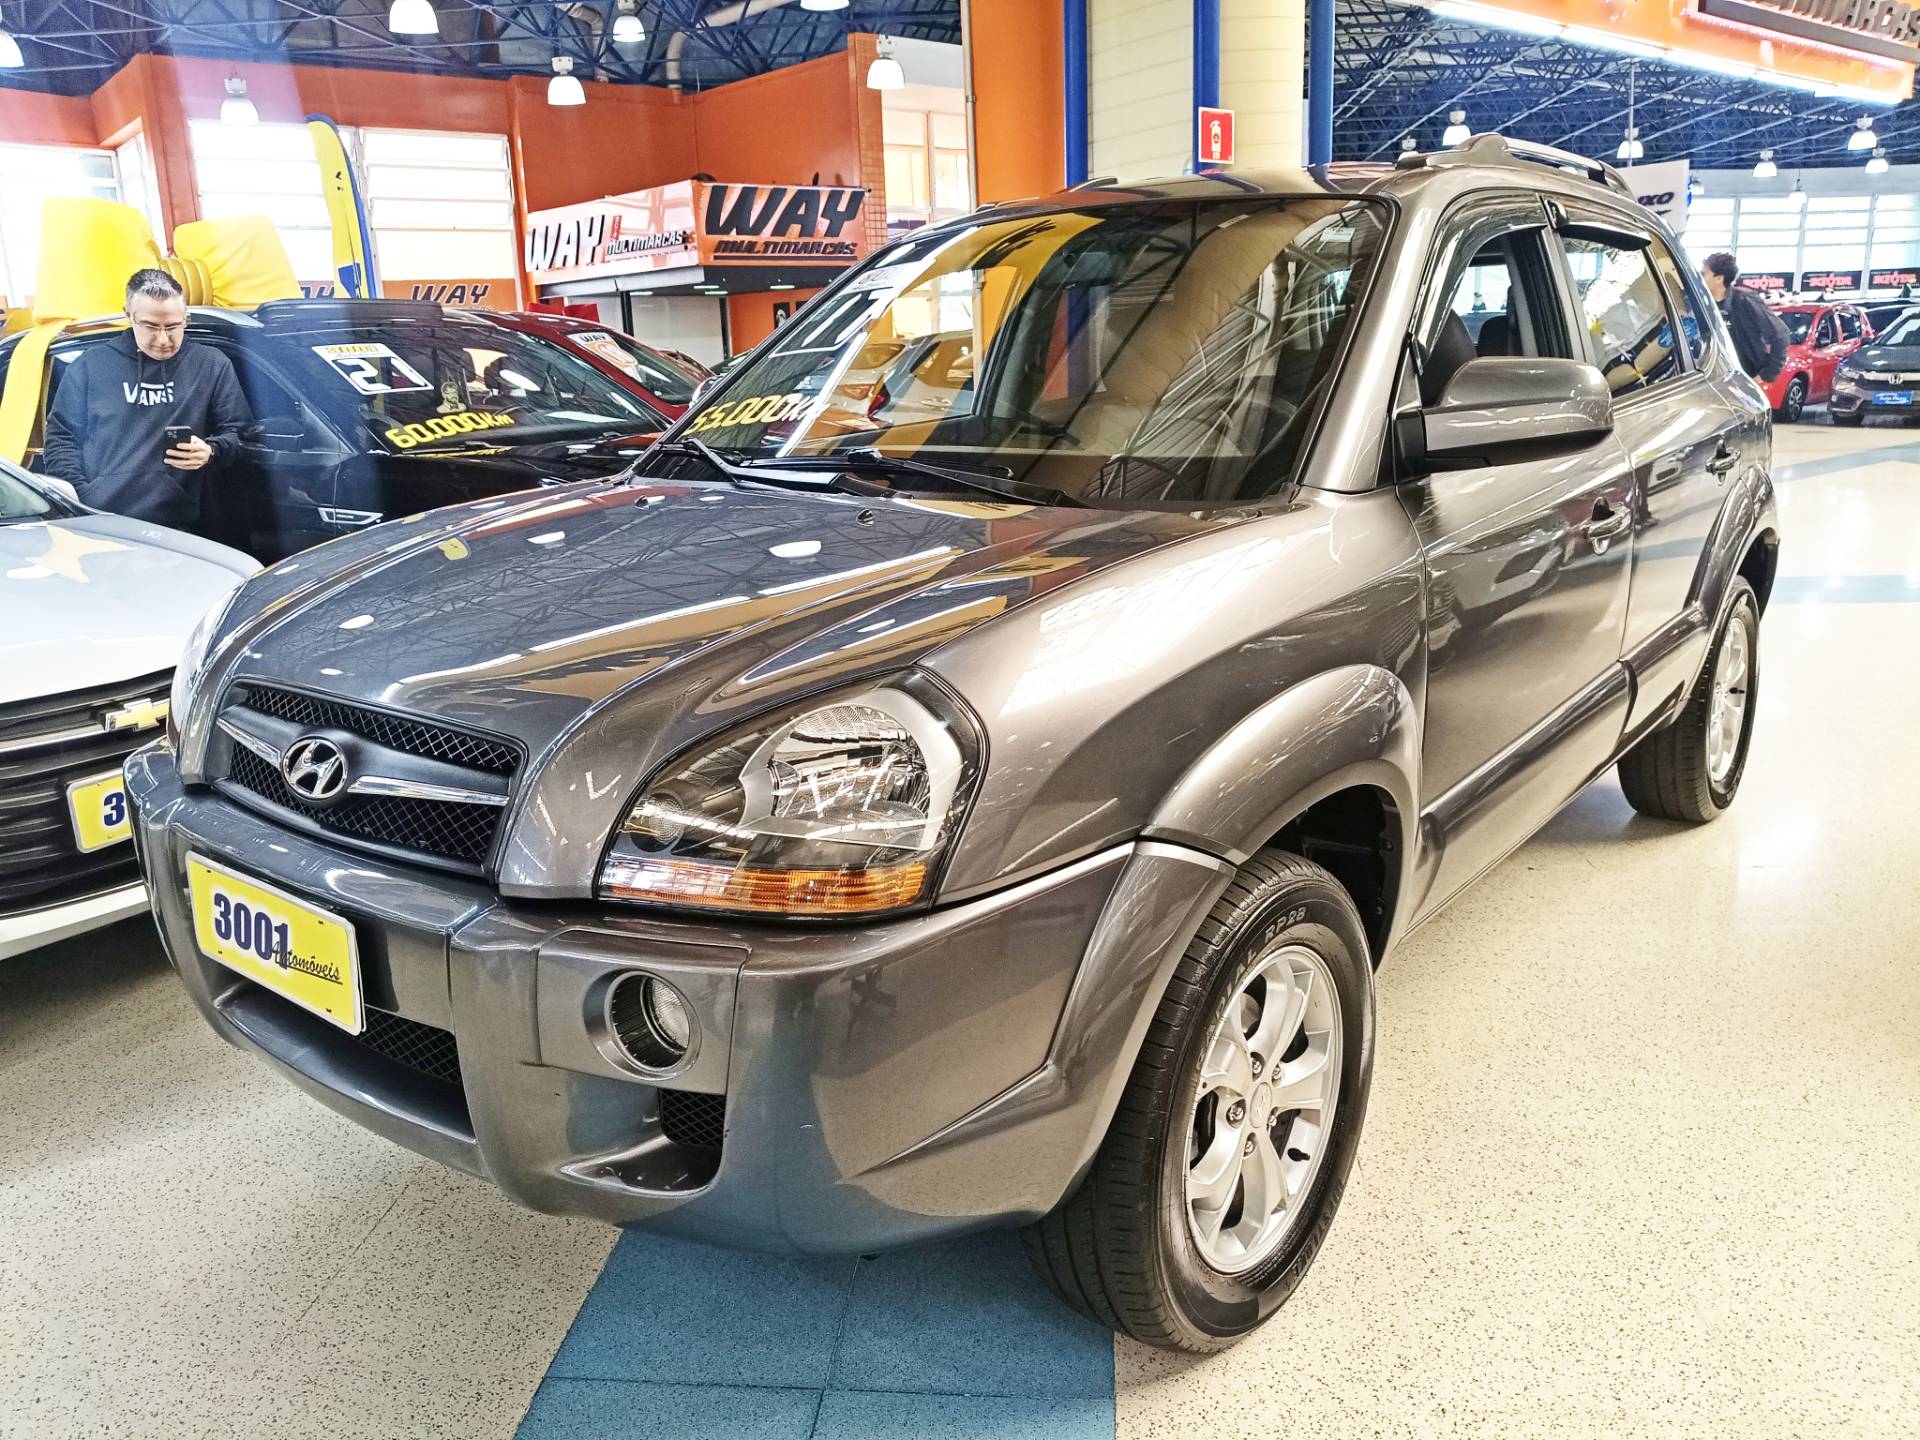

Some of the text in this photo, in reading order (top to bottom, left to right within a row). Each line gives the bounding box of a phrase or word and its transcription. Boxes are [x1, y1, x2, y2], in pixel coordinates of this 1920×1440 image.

[704, 185, 866, 238] WAY
[525, 215, 605, 272] WAY
[606, 231, 684, 256] MULTIMARCAS
[714, 238, 858, 256] MULTIMARCAS
[411, 284, 490, 304] WAY
[580, 334, 607, 343] WAY
[336, 357, 427, 392] 21
[122, 381, 175, 406] VANS
[213, 893, 289, 969] 3001
[1264, 906, 1307, 944] RP28
[270, 941, 342, 982] Automóveis
